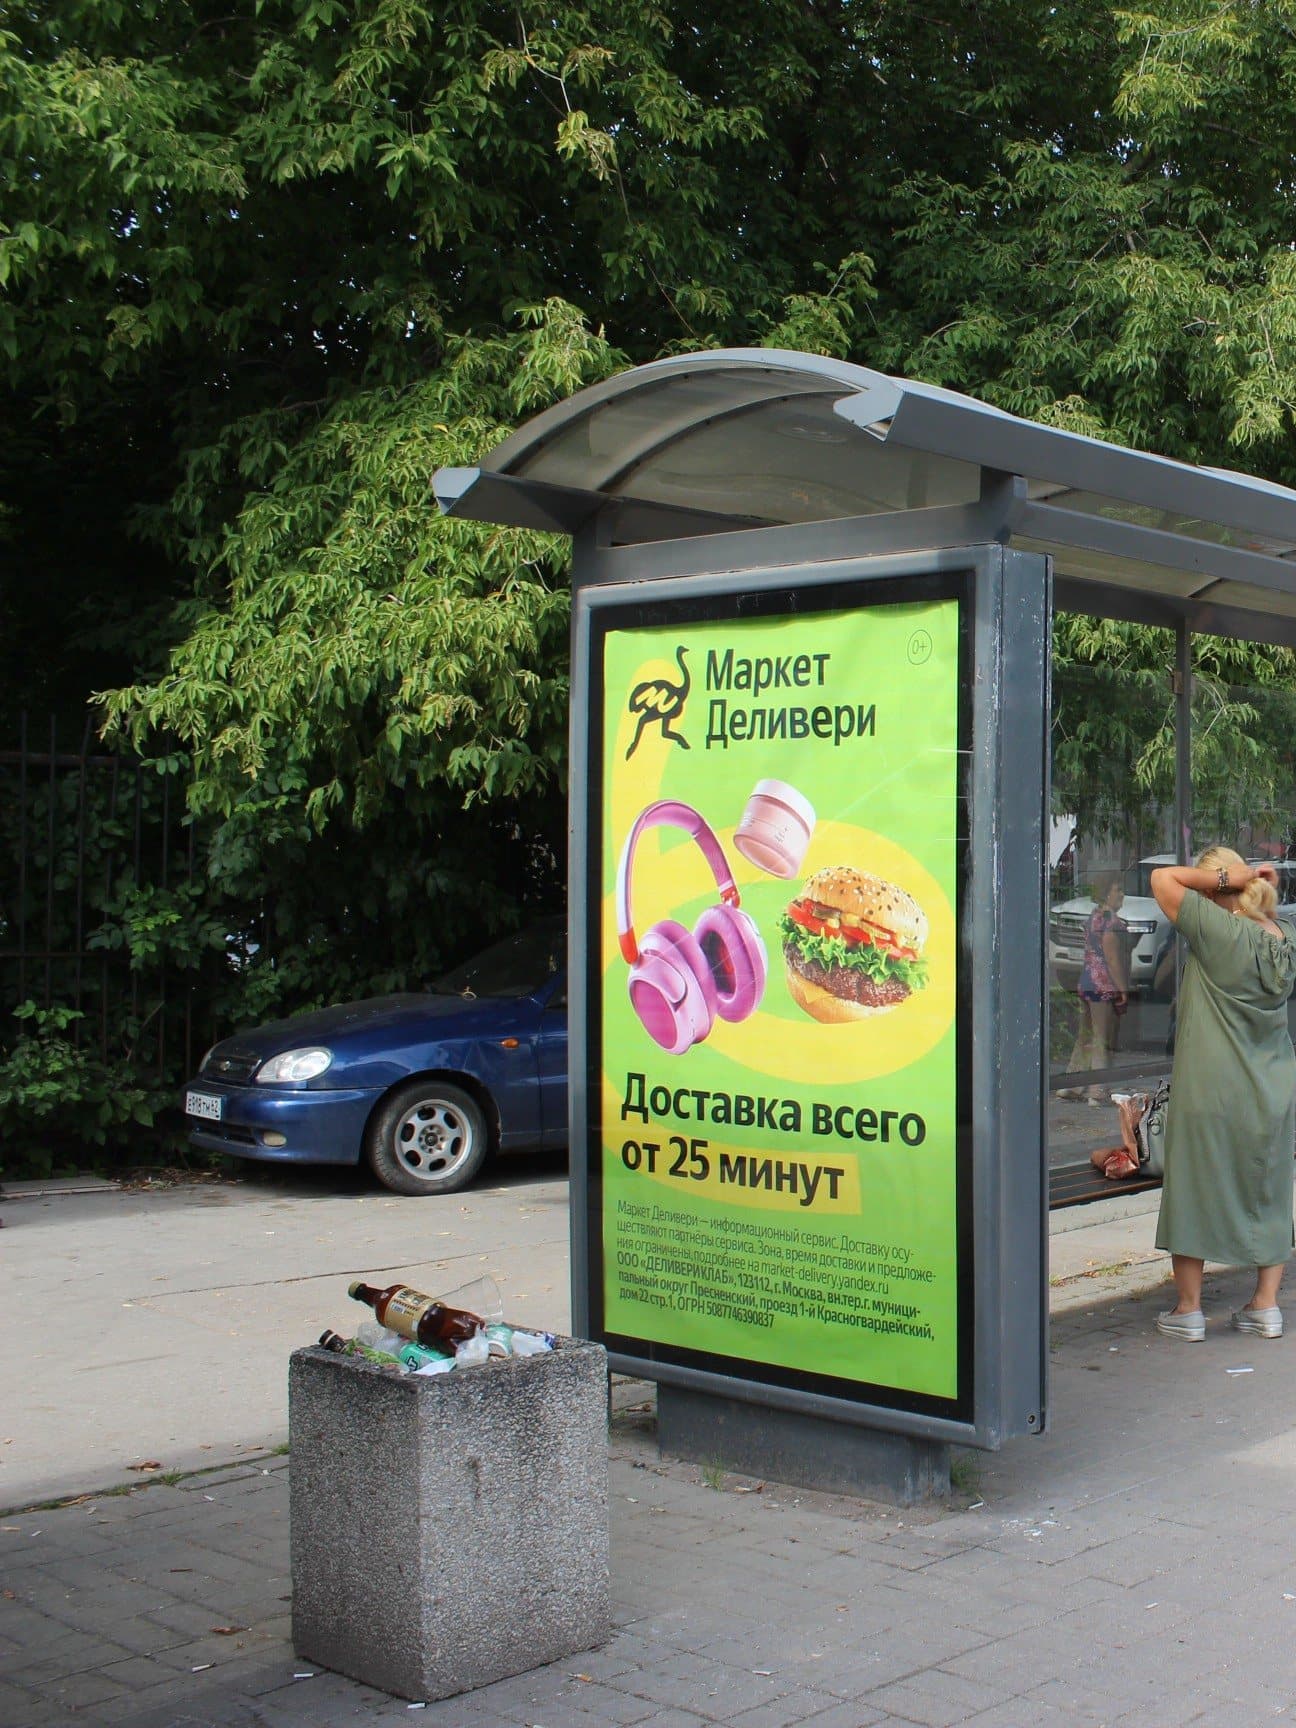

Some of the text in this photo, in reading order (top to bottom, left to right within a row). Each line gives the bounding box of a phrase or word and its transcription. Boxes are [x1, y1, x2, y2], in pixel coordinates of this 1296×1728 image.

[705, 648, 831, 697] Маркет
[705, 699, 877, 749] Деливери
[620, 1071, 928, 1147] Доставка всего
[620, 1135, 845, 1207] от 25 минут
[617, 1200, 651, 1218] Маркет
[652, 1205, 699, 1226] Деливери
[710, 1217, 800, 1242] информационный
[840, 1235, 890, 1261] Доставку
[891, 1245, 914, 1263] осу-
[617, 1220, 667, 1238] ществляют
[714, 1235, 755, 1254] сервиса.
[785, 1248, 817, 1263] время
[819, 1253, 867, 1273] доставки
[868, 1261, 876, 1273] и
[877, 1263, 937, 1283] предложе-
[617, 1237, 634, 1250] ния
[693, 1249, 746, 1271] подробнее
[748, 1259, 760, 1271] на
[762, 1261, 889, 1294] market-delivery.yandex.ru
[617, 1251, 639, 1268] ООО
[738, 1272, 773, 1293] 123112,
[774, 1282, 782, 1294] г.
[782, 1280, 826, 1304] Москва,
[872, 1300, 921, 1320] муници-
[618, 1270, 935, 1341] пальный округ Пресненский, проезд 1-й Красногвардейский,
[619, 1287, 639, 1301] дом
[639, 1288, 649, 1303] 22
[677, 1296, 705, 1315] ОГРН
[707, 1301, 775, 1328] 5087746390837
